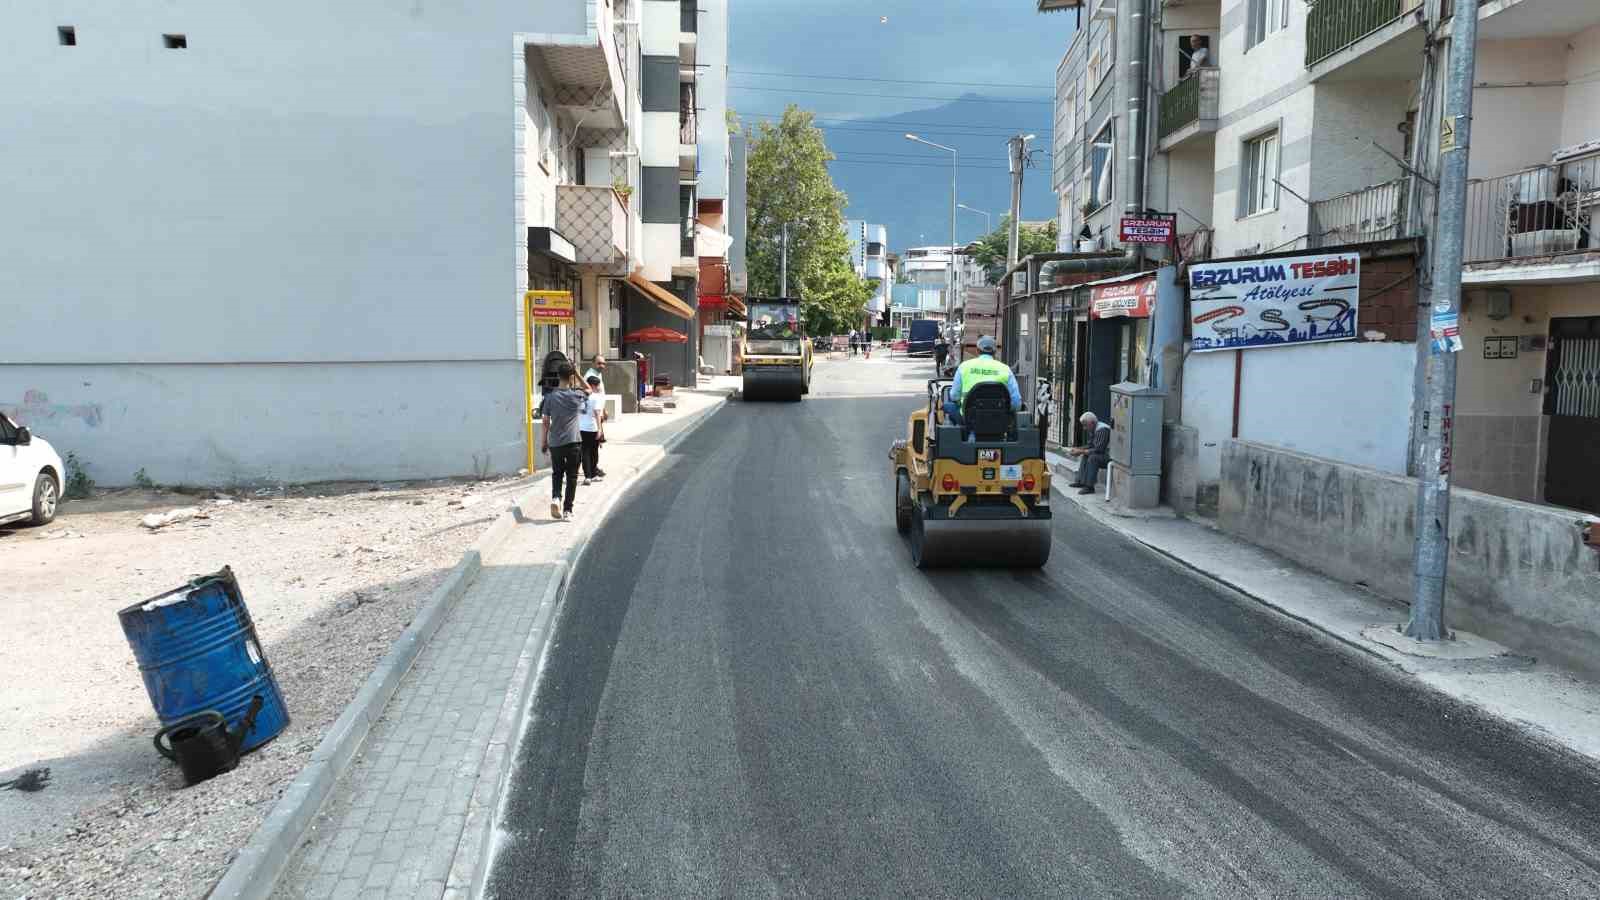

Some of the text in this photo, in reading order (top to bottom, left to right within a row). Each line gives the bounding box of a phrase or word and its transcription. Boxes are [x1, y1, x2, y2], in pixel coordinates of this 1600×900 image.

[1191, 256, 1356, 287] ERZURUM TESBİH
[1243, 284, 1315, 302] Atölyesi
